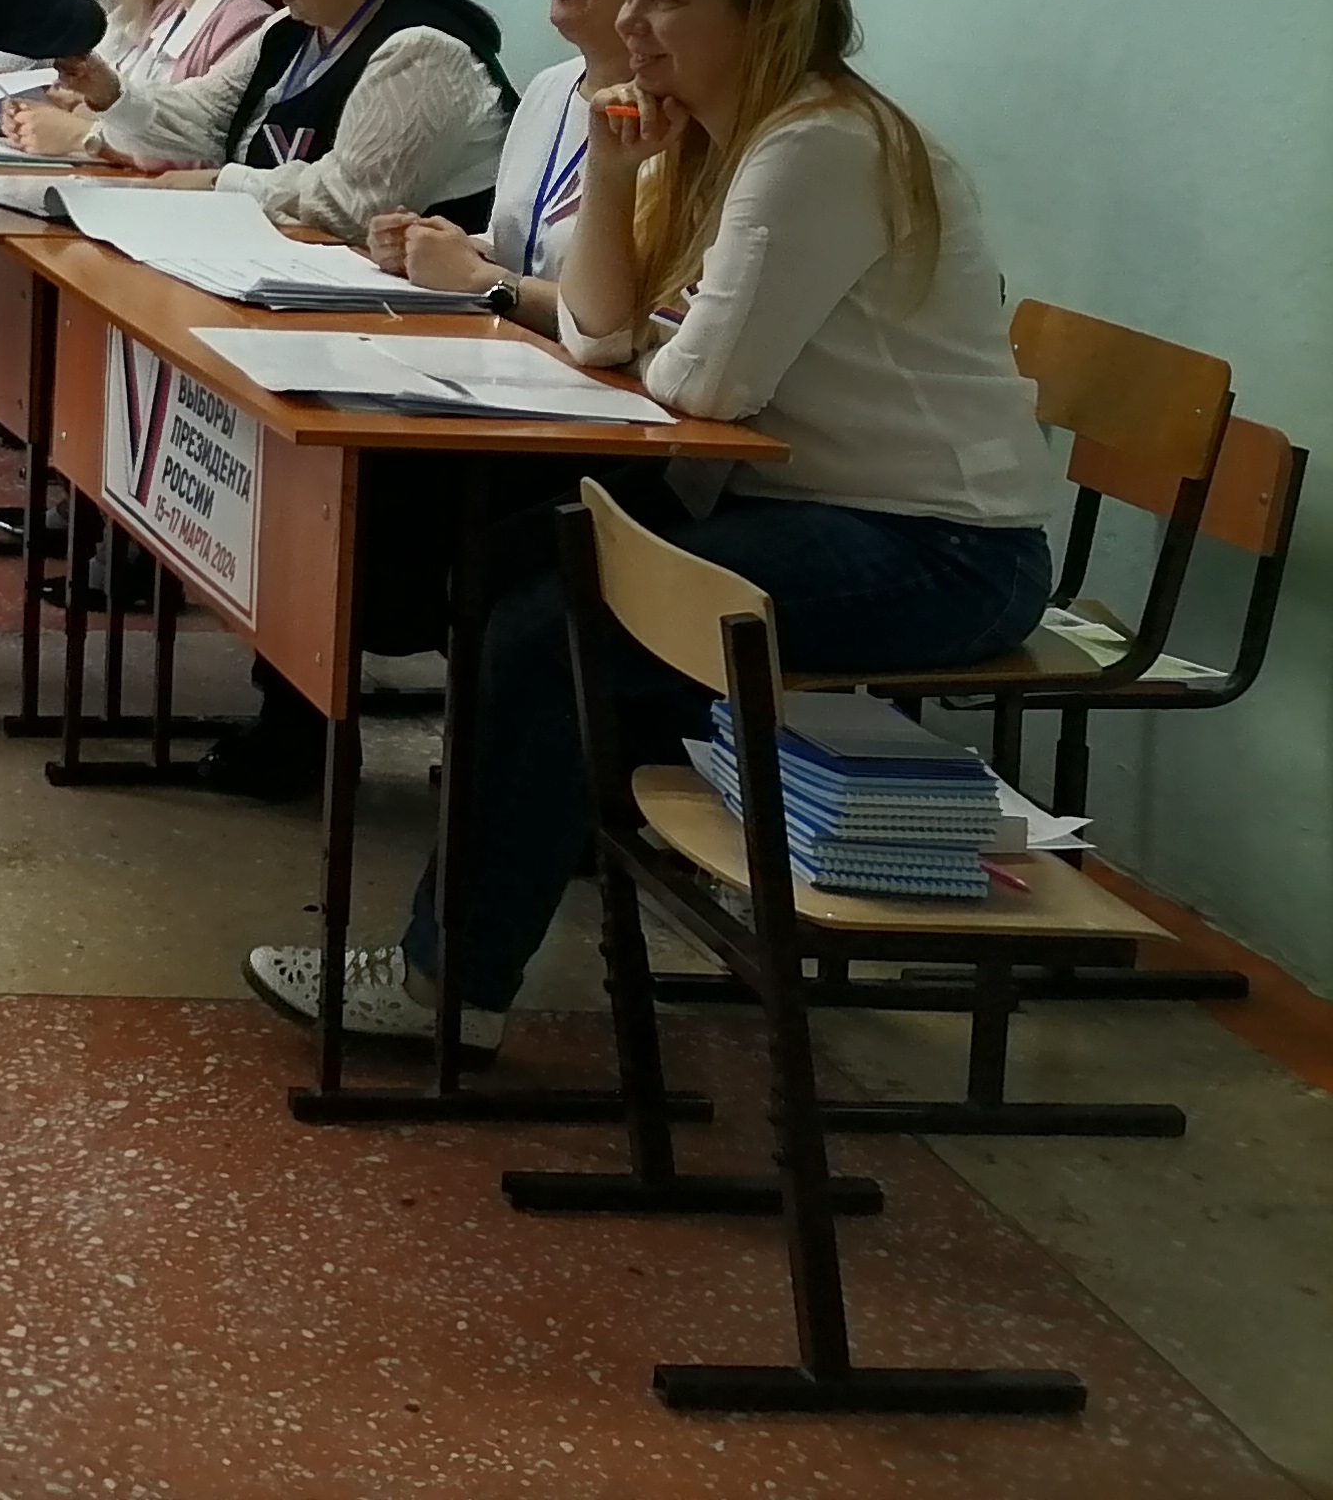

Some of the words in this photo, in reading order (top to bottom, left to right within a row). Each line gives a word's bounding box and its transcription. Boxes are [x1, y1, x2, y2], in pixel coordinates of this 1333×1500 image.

[177, 374, 237, 439] ВЫБОРЫ
[162, 455, 215, 520] РОССИИ
[170, 414, 252, 504] ПРЕЗИДЕНТА
[179, 514, 212, 565] МАРТА
[211, 541, 237, 583] 2024
